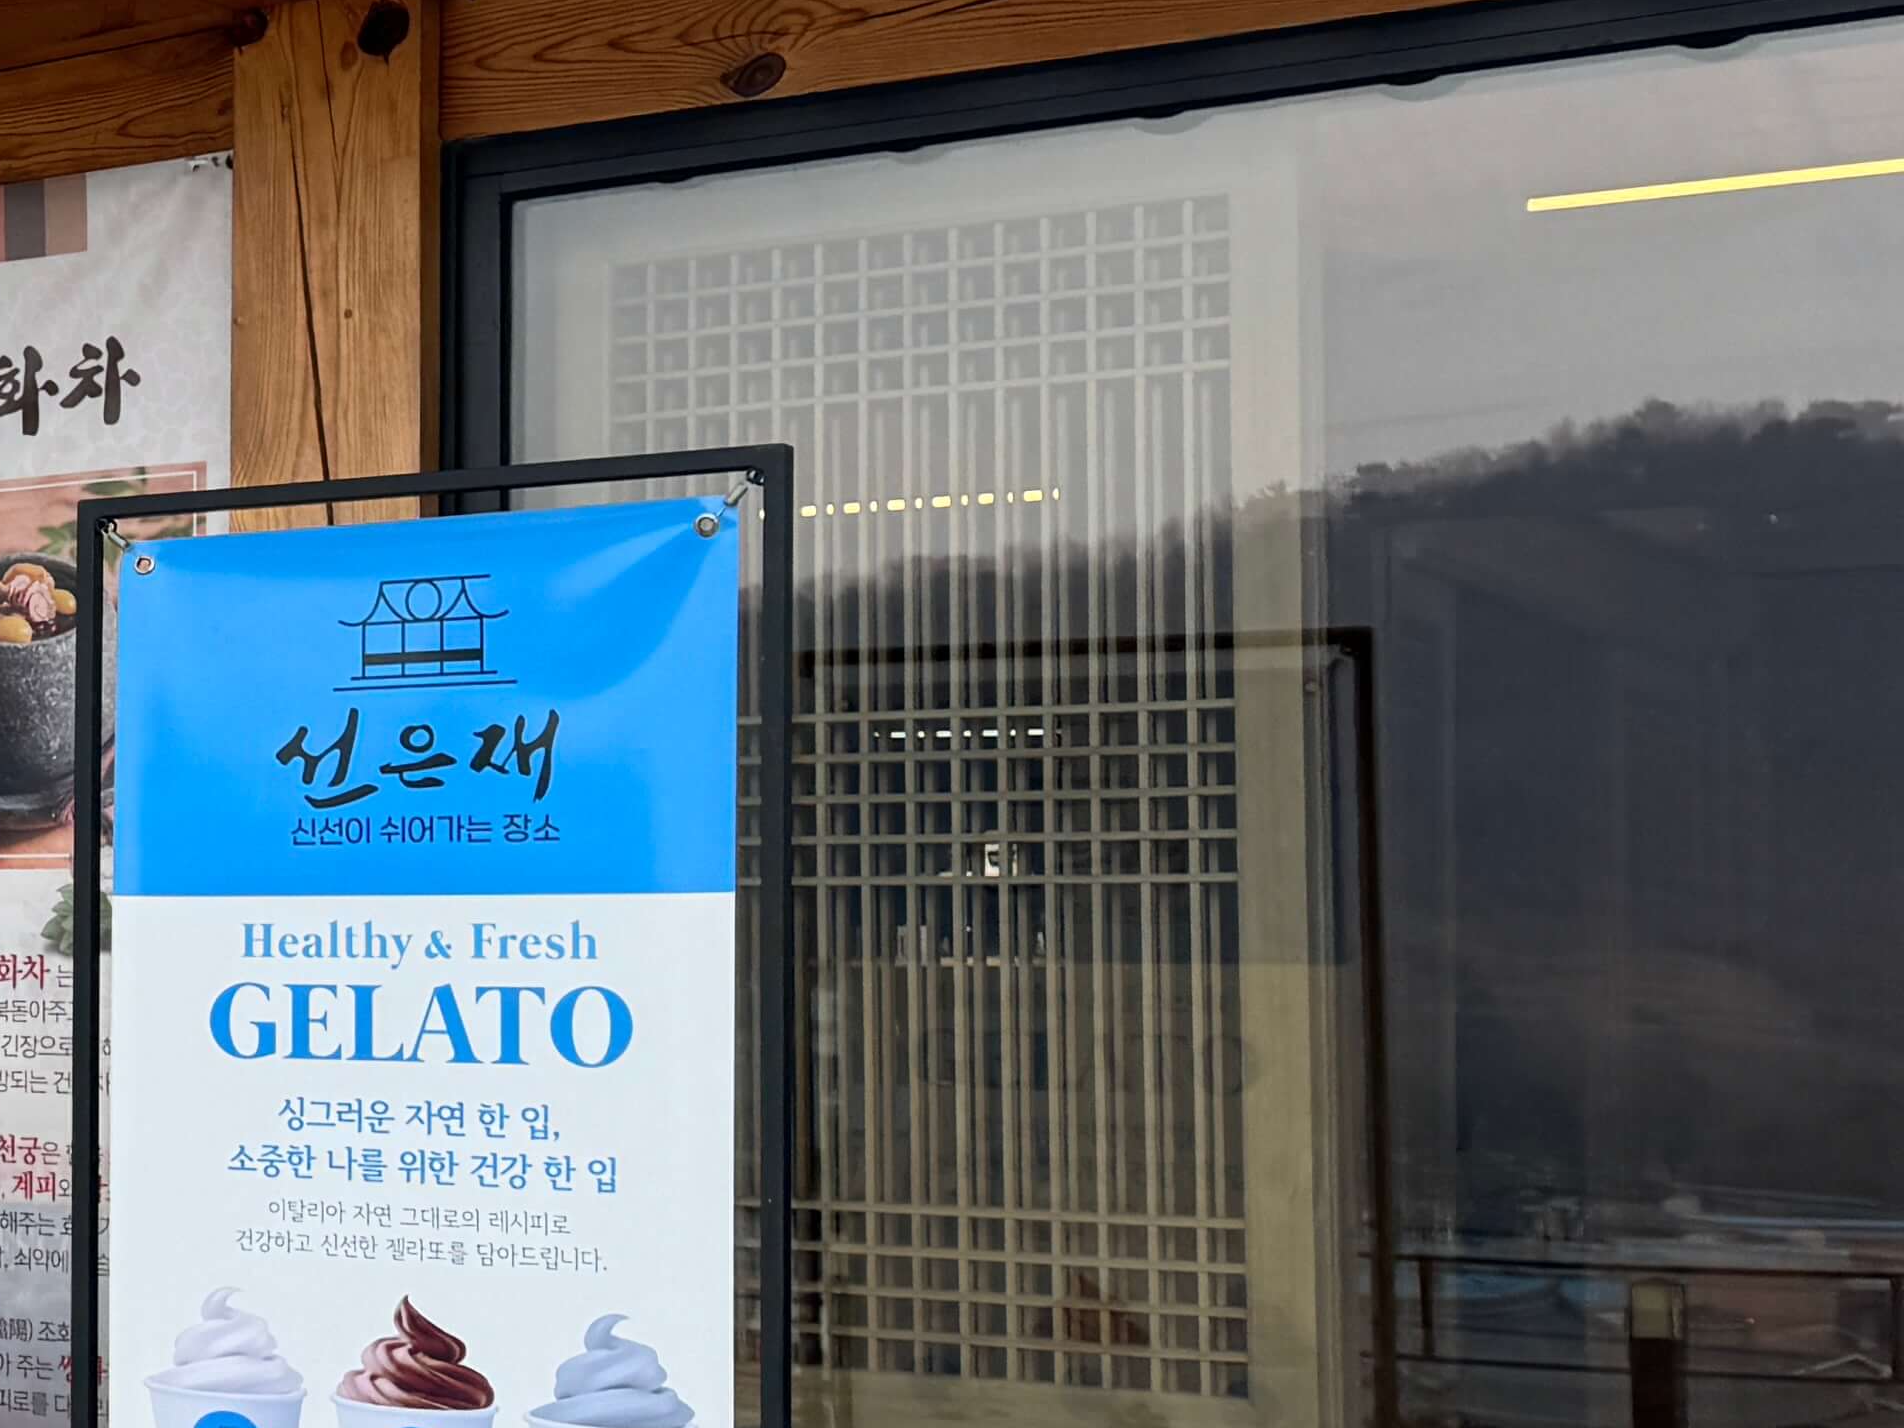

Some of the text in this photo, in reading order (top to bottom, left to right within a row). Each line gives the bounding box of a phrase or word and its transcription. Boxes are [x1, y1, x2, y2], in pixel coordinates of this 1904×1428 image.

[276, 706, 561, 810] 선은재
[290, 813, 561, 846] 신선이 쉬어가는 장소
[241, 918, 598, 969] Healthy & Fresh
[208, 981, 633, 1069] GELATO
[279, 1097, 561, 1141] 싱그러운 자연 한 입,
[227, 1144, 618, 1194] 소중한 나를 위한 건강 한 입
[0, 1211, 54, 1237] 해주는
[268, 1198, 571, 1236] 이탈리아 자연 그대로의 레시피로
[235, 1229, 608, 1274] 건강하고 신선한 젤라또를 담아드립니다.
[16, 1354, 54, 1381] 주는
